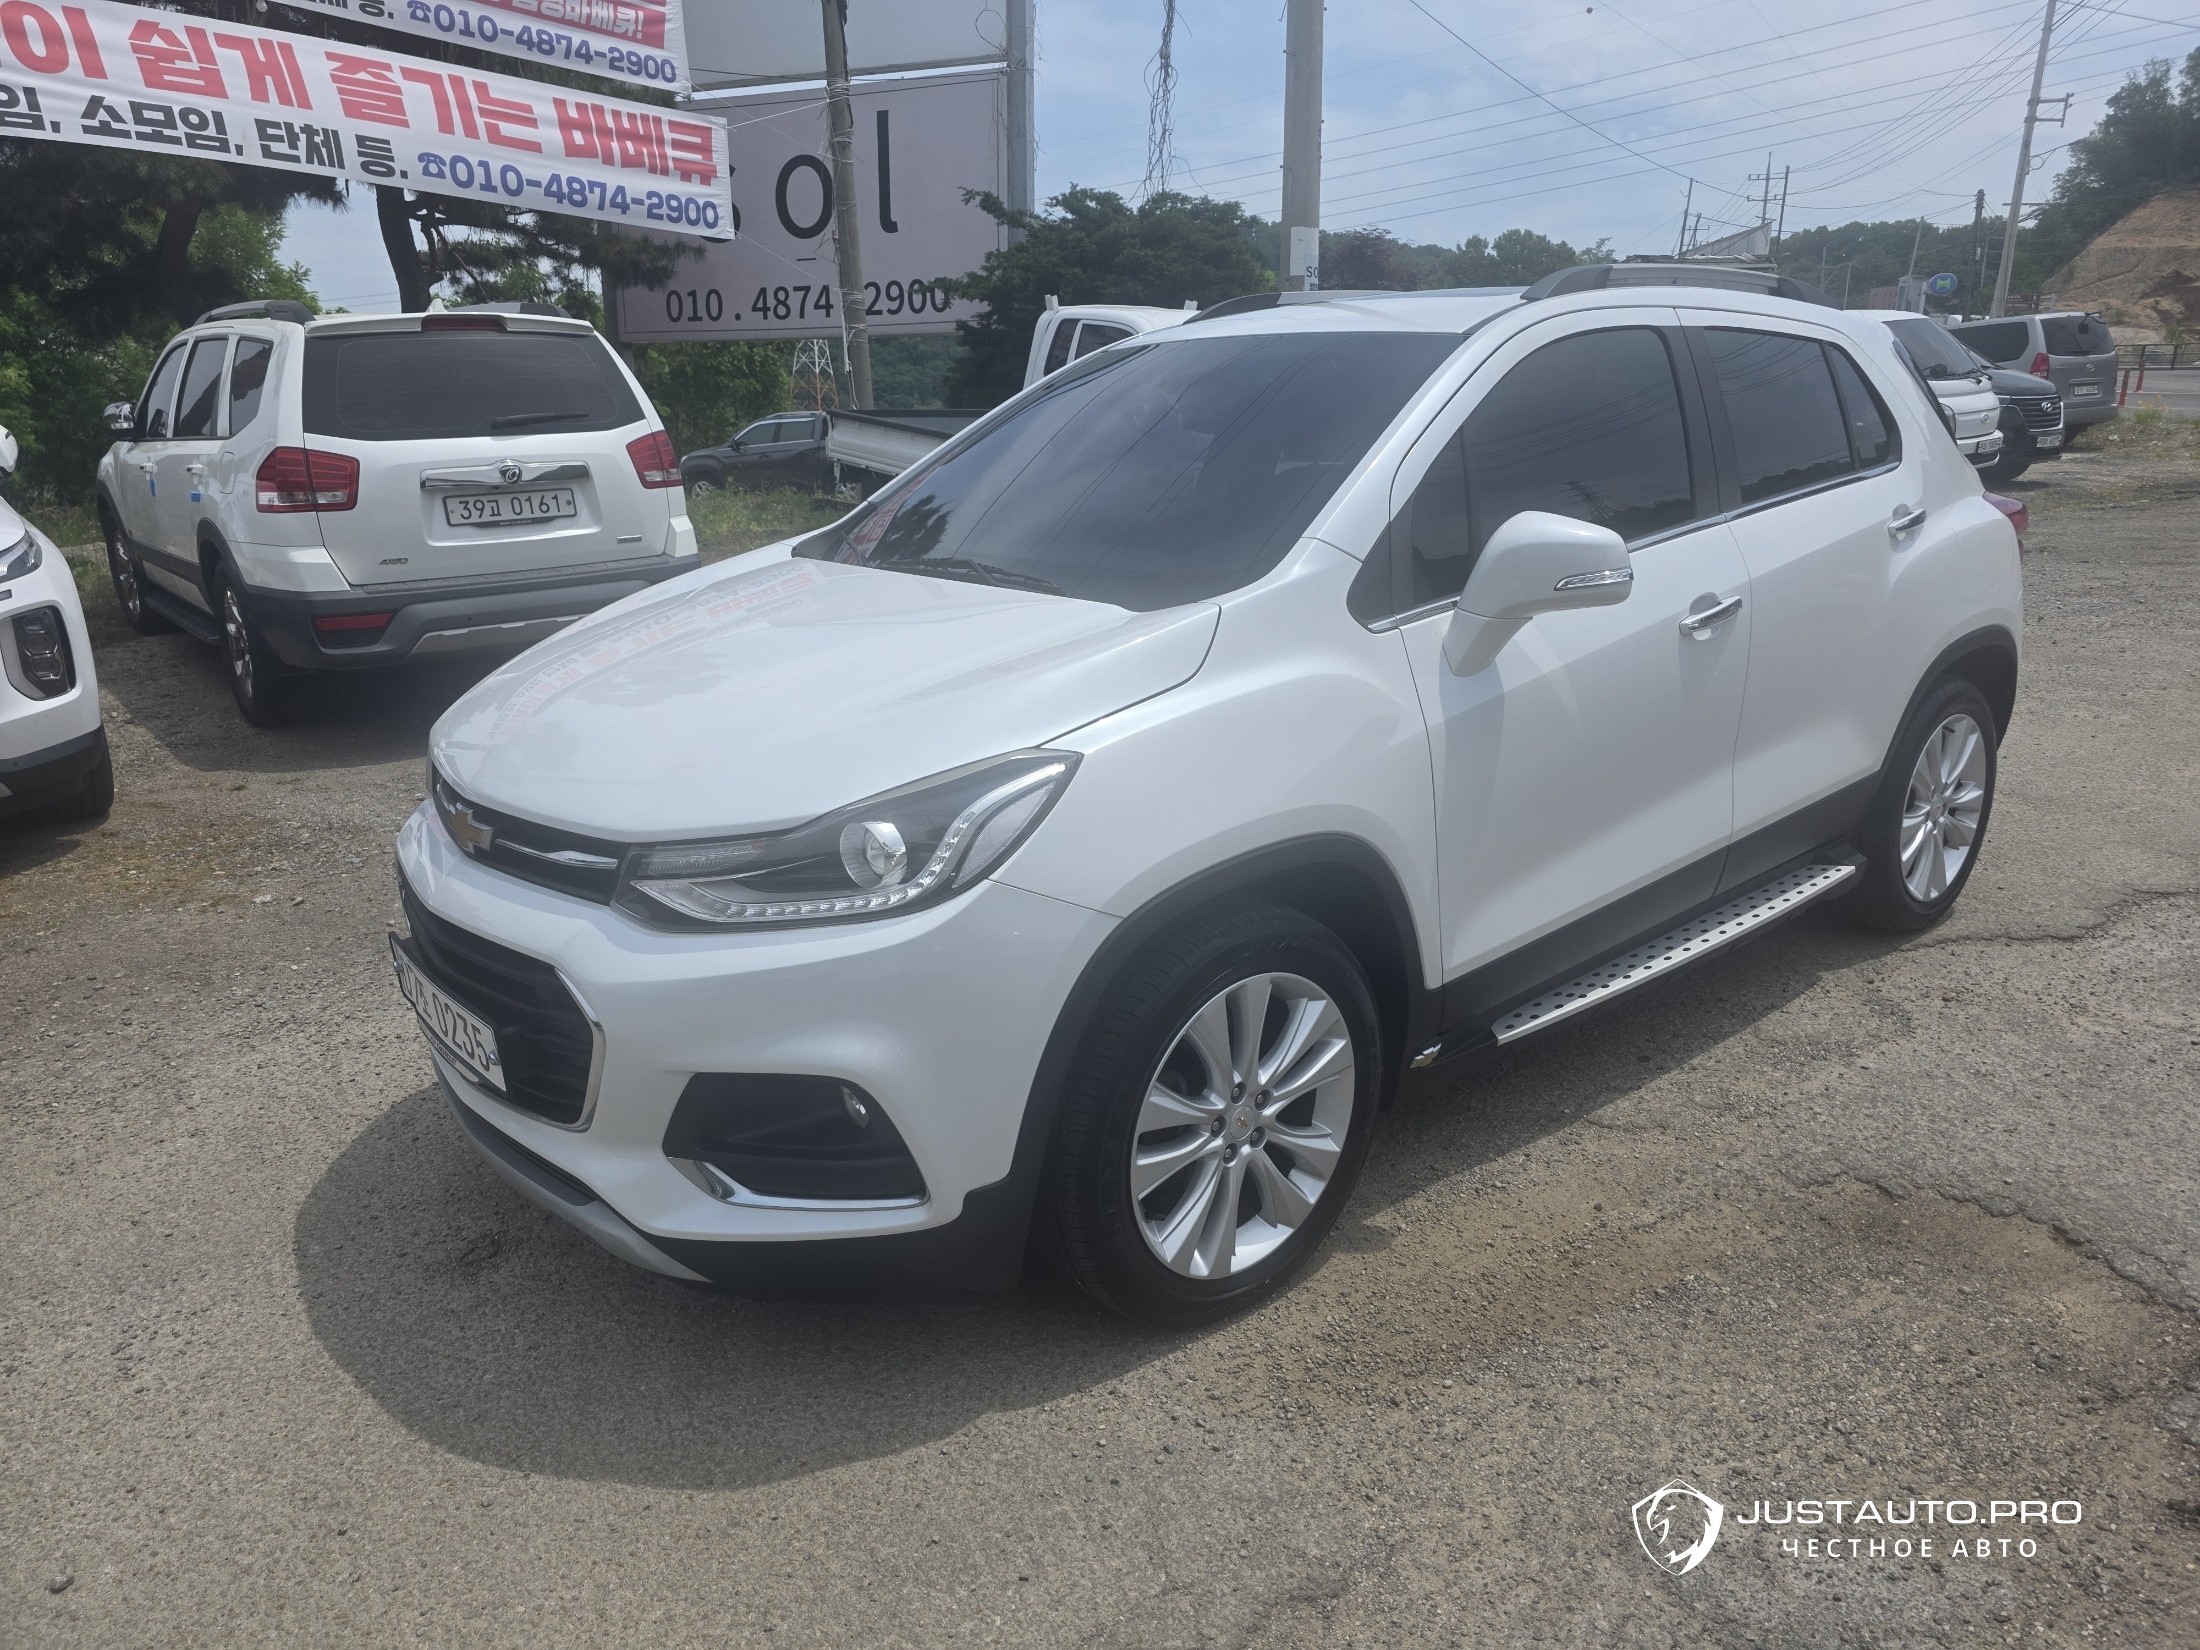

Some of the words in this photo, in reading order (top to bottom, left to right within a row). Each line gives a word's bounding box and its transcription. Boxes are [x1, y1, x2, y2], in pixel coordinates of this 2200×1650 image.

[433, 5, 677, 84] 010-4874-2900
[128, 19, 313, 111] 쉽게
[324, 51, 543, 154] 즐기는
[552, 97, 718, 186] 바베큐
[81, 95, 244, 156] 소모임,
[254, 118, 345, 170] 단체
[356, 134, 408, 180] 등.
[449, 154, 720, 229] 010-4874-2900
[699, 110, 899, 243] ol
[510, 493, 561, 516] 0161
[432, 992, 490, 1072] 0235
